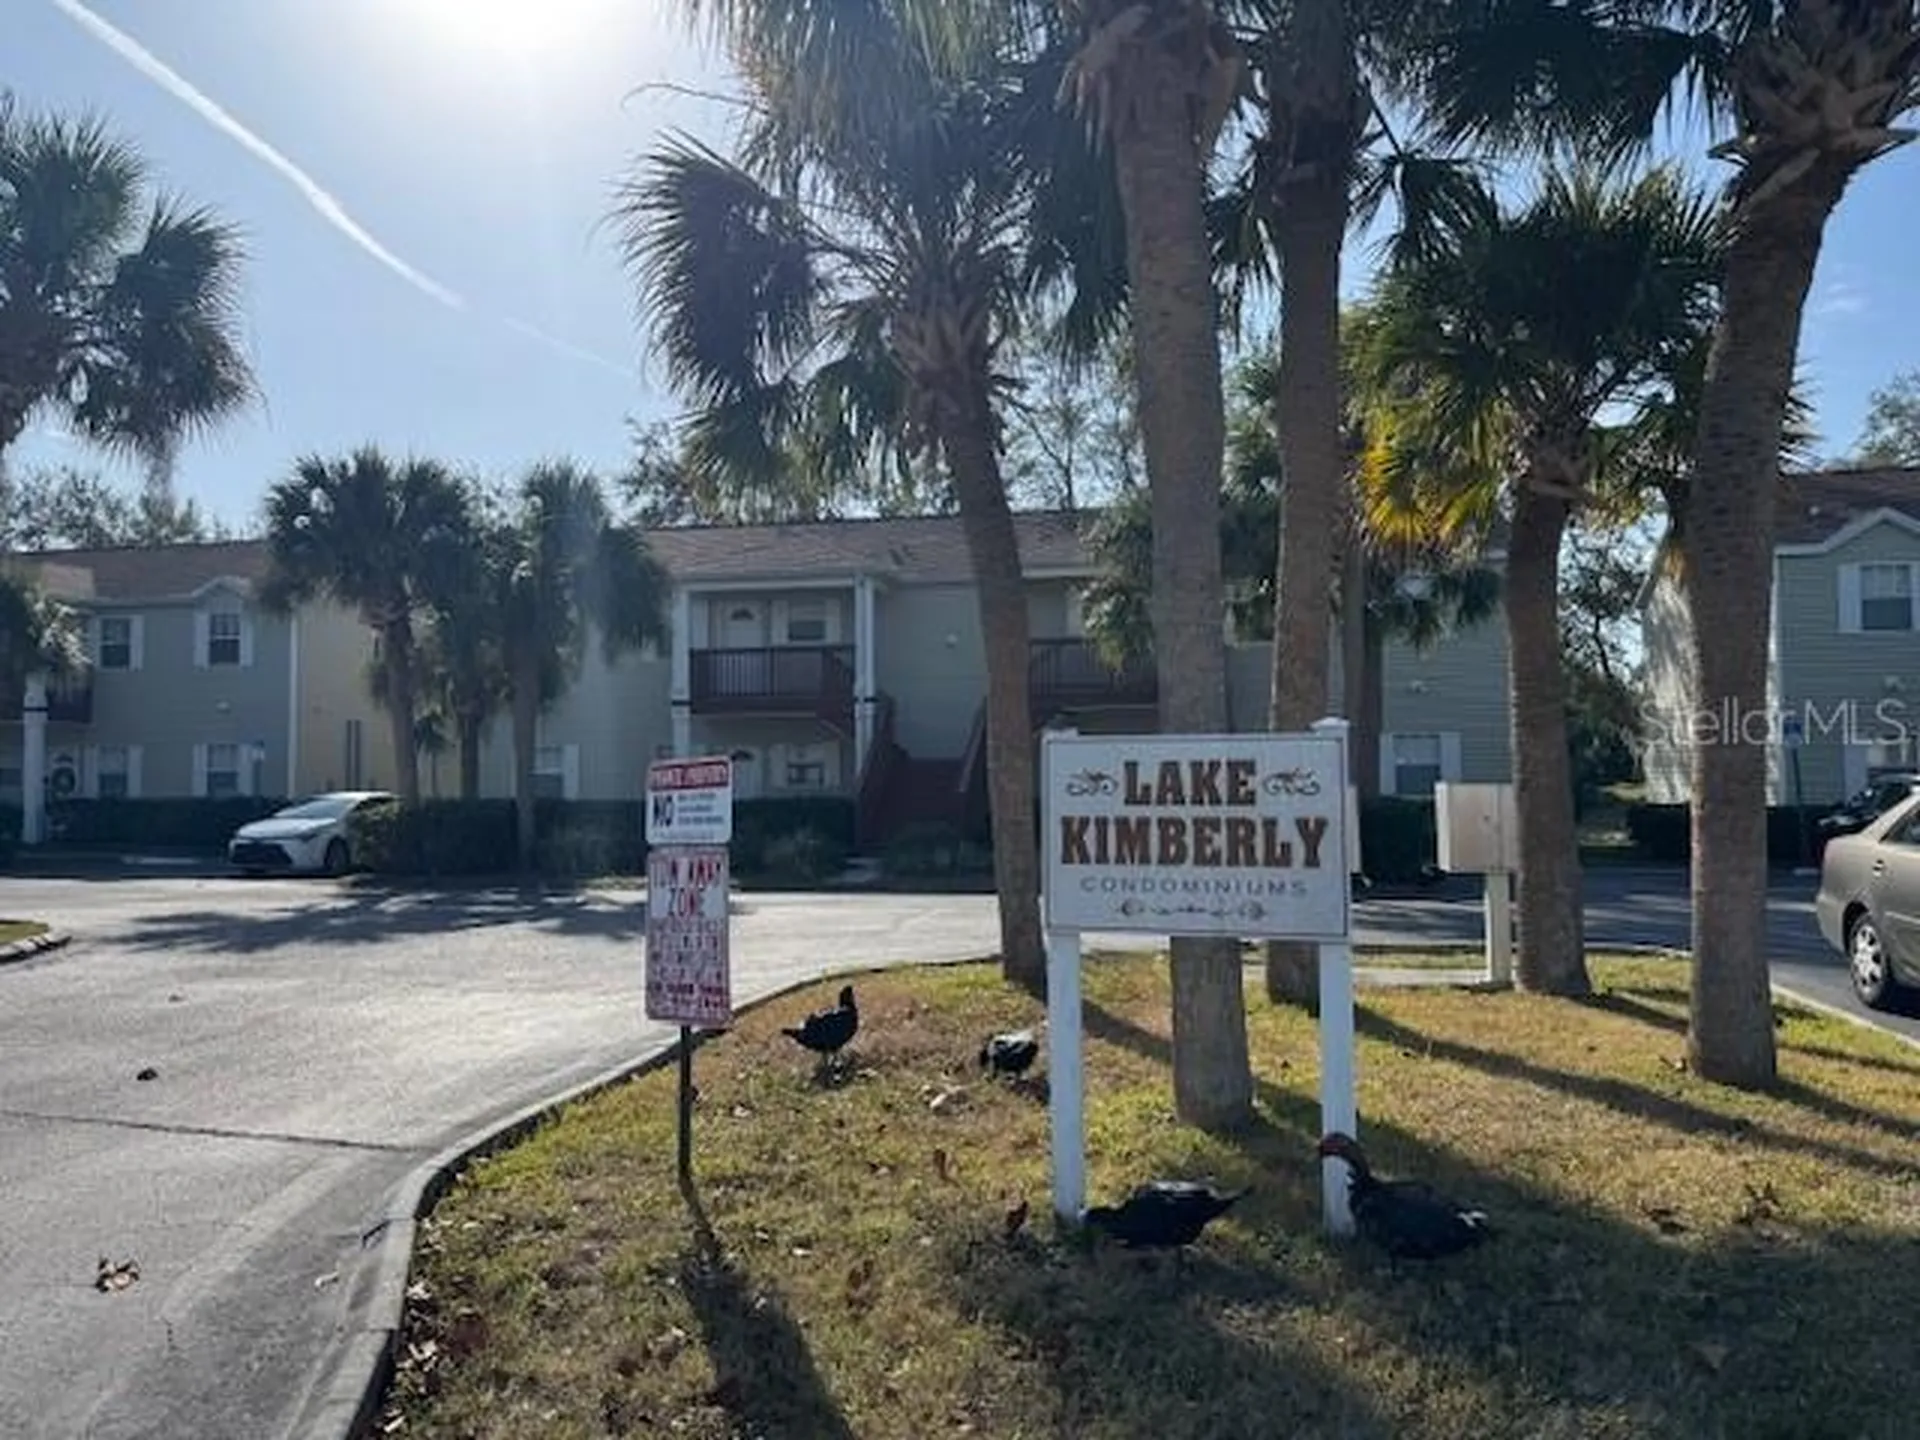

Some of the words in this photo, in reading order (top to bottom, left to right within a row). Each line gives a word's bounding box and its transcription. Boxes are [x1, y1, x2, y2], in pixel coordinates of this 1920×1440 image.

[1123, 758, 1257, 807] LAKE
[1060, 815, 1329, 869] KIMBERLY
[1080, 875, 1308, 896] CONDOMINIUMS
